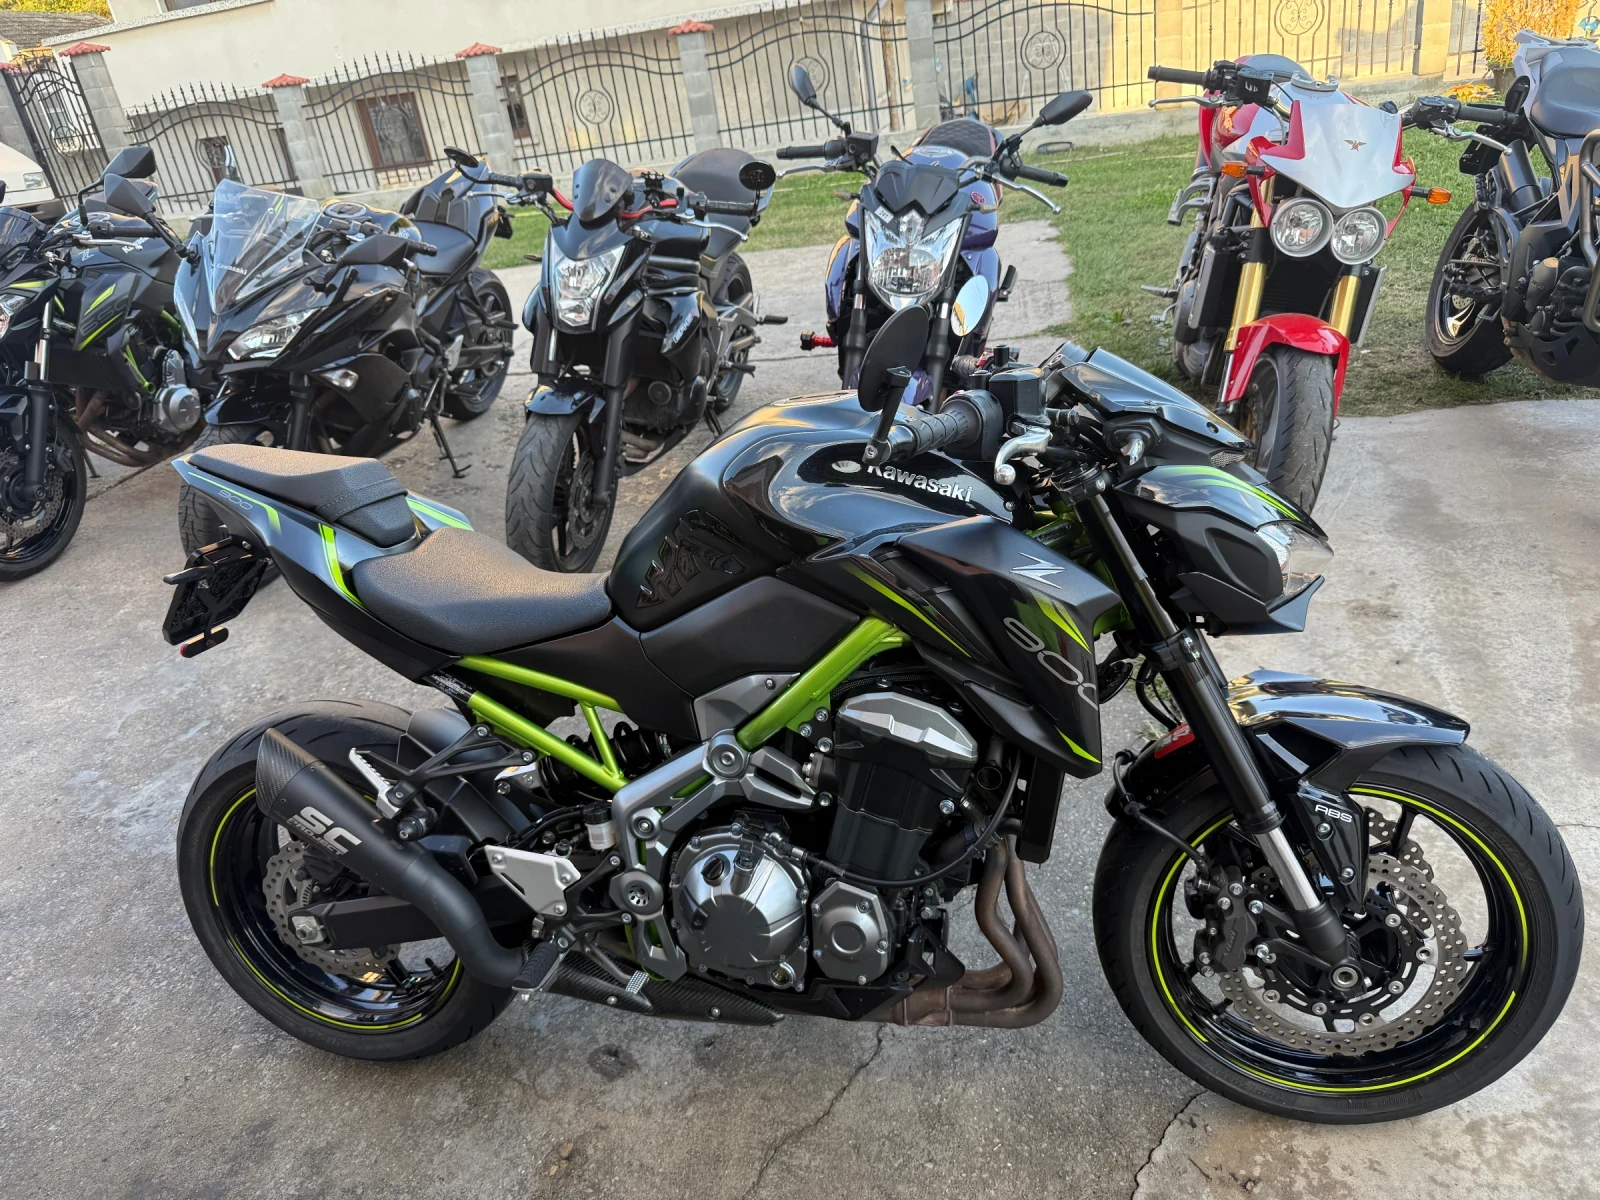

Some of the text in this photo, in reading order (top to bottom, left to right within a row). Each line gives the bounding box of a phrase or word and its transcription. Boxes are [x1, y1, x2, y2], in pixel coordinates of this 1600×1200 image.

[867, 464, 974, 503] Kawasaki
[217, 489, 253, 510] 900
[1315, 804, 1353, 823] ABS
[292, 806, 363, 856] SC
